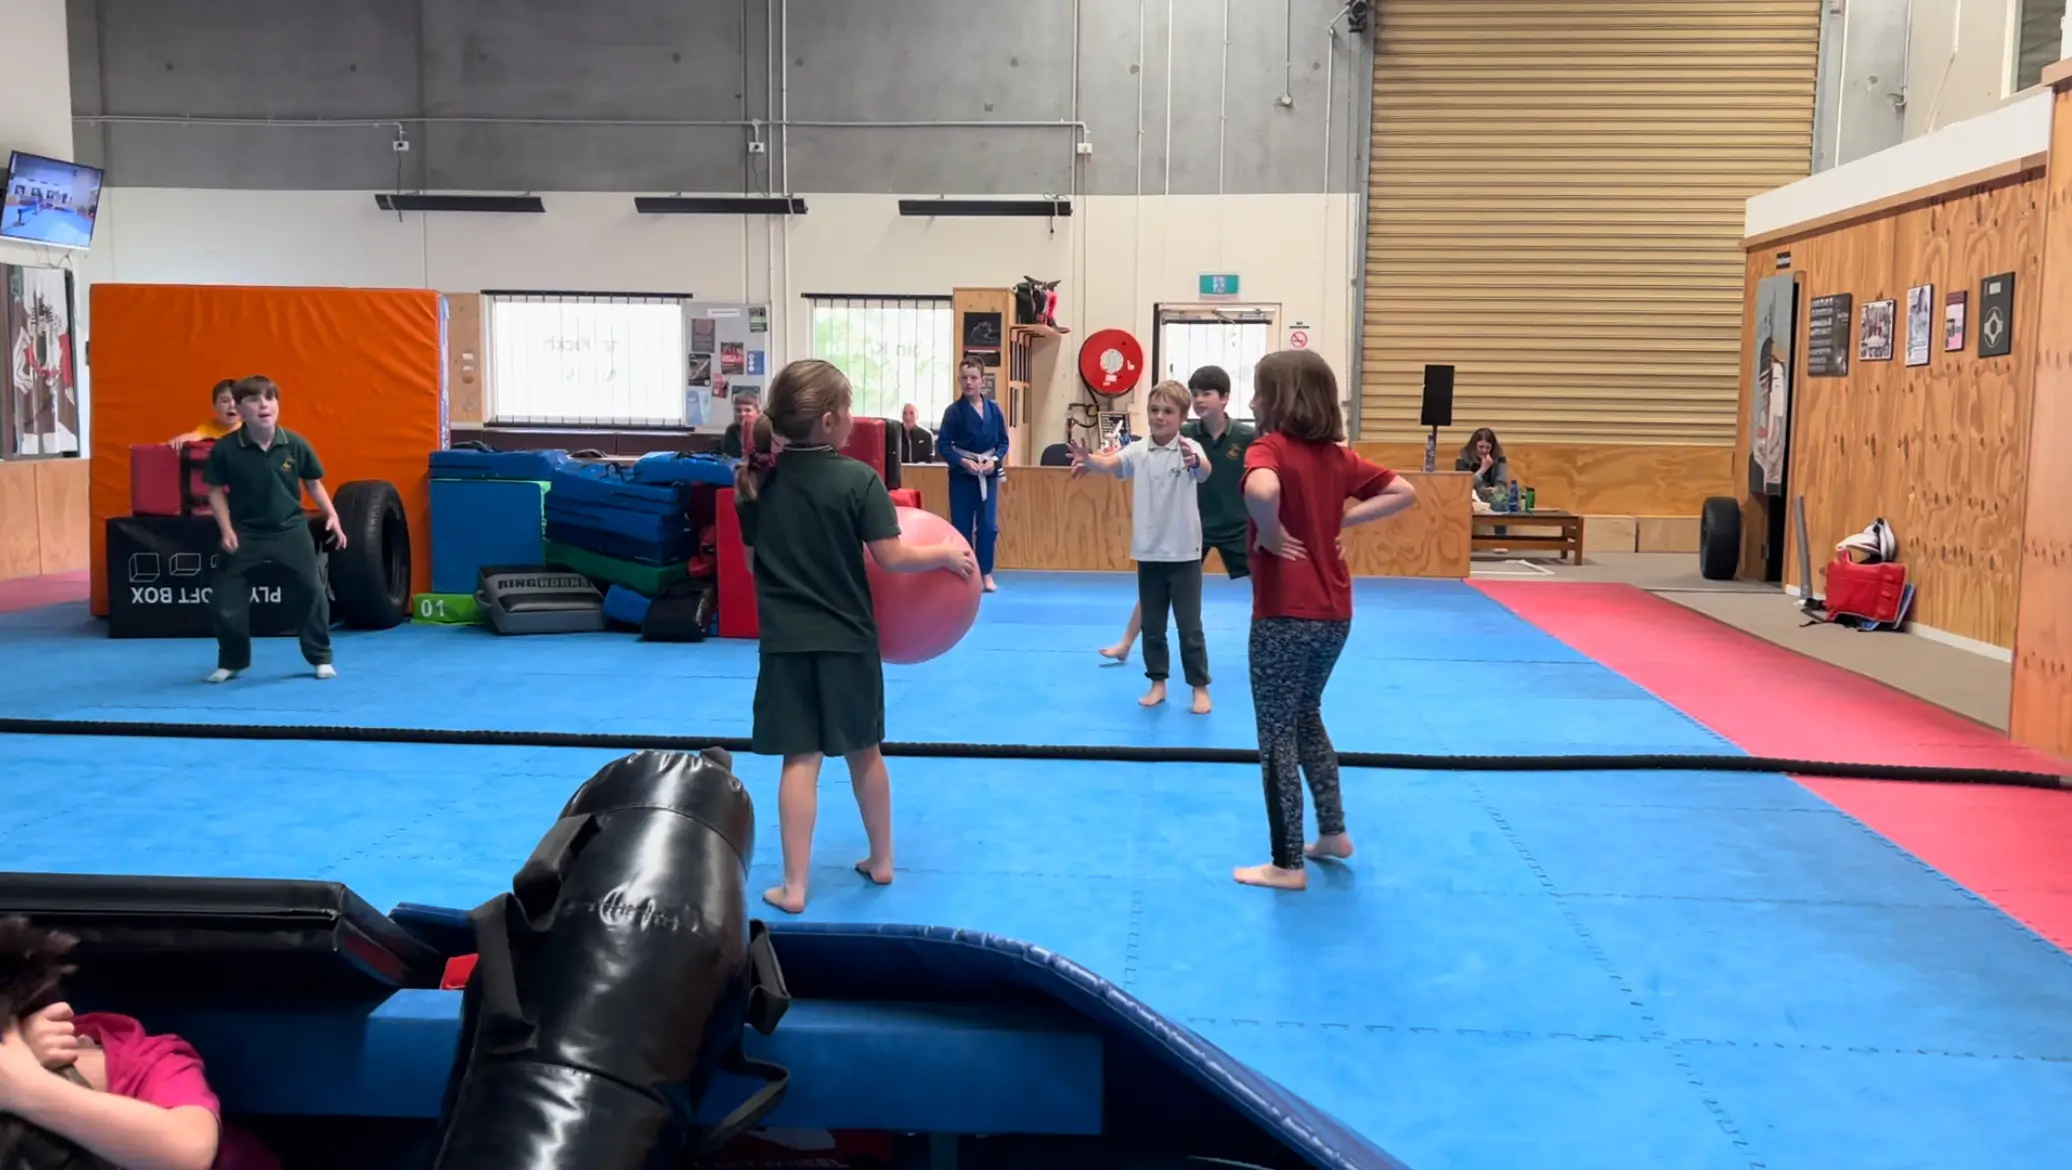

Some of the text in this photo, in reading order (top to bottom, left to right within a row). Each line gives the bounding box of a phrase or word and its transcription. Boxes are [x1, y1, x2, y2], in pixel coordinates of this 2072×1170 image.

[130, 586, 281, 604] PLY OFT BOX
[421, 599, 445, 617] 01
